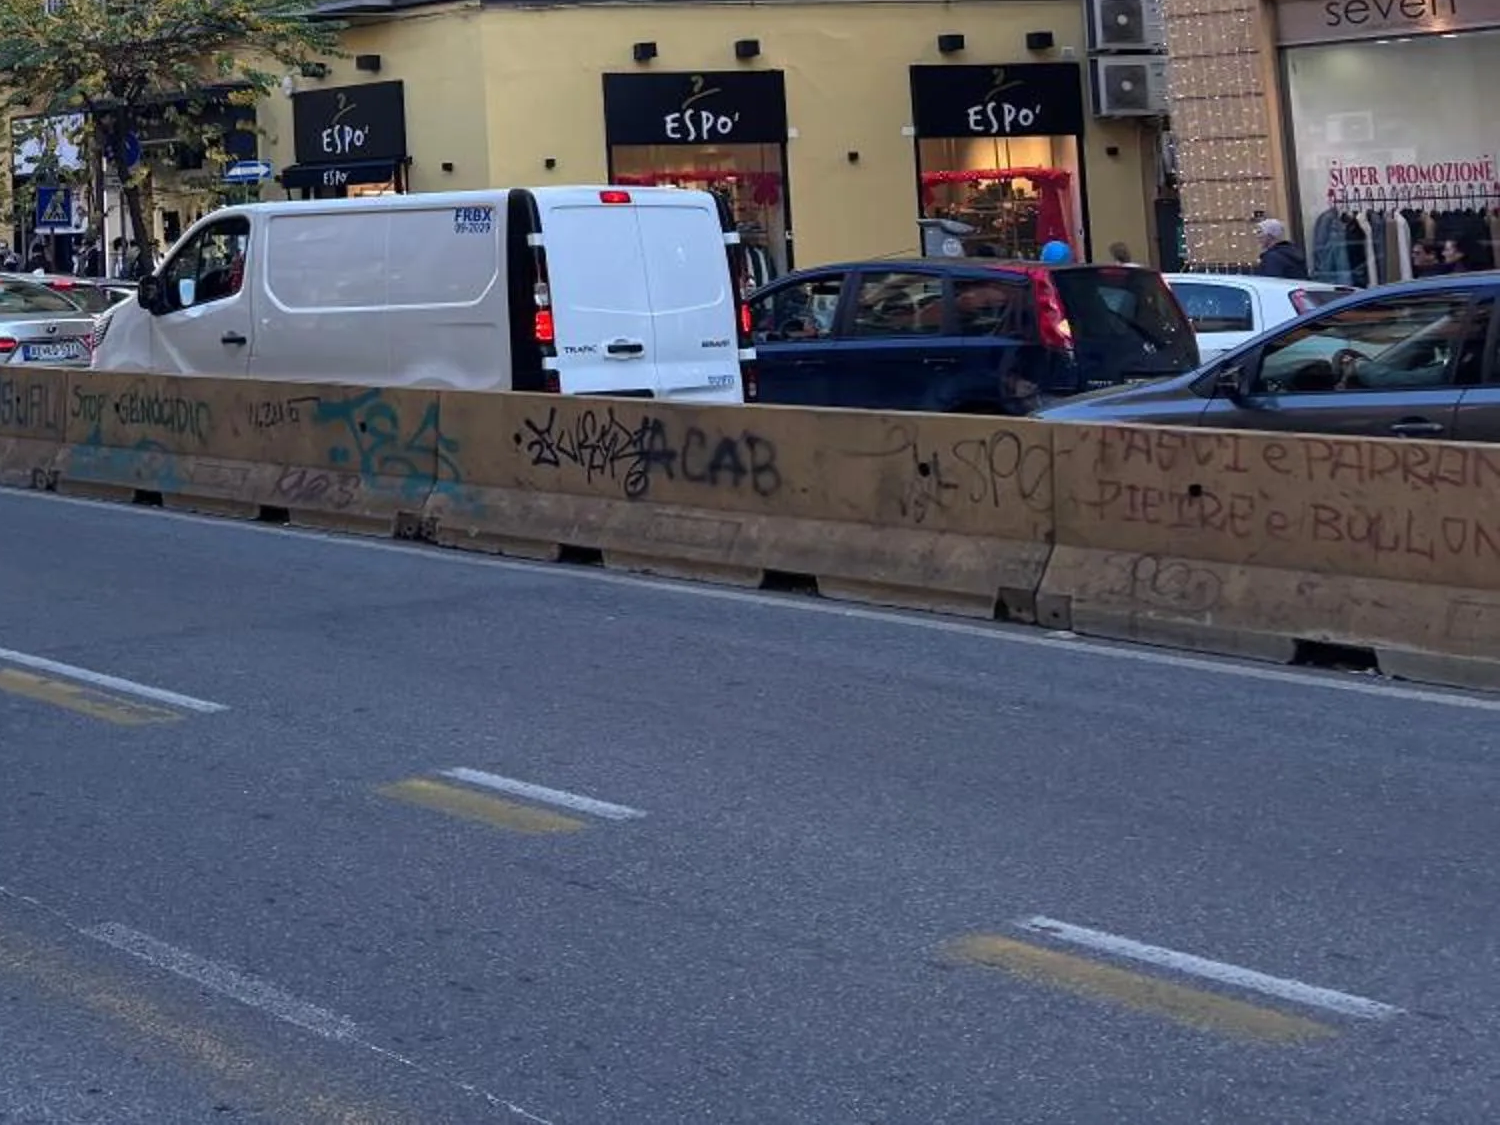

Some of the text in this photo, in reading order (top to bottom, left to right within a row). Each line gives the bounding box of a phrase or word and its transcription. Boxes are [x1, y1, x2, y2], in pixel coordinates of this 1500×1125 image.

[1329, 160, 1496, 187] SUPER PROMOZIONE
[633, 415, 783, 497] ACAB
